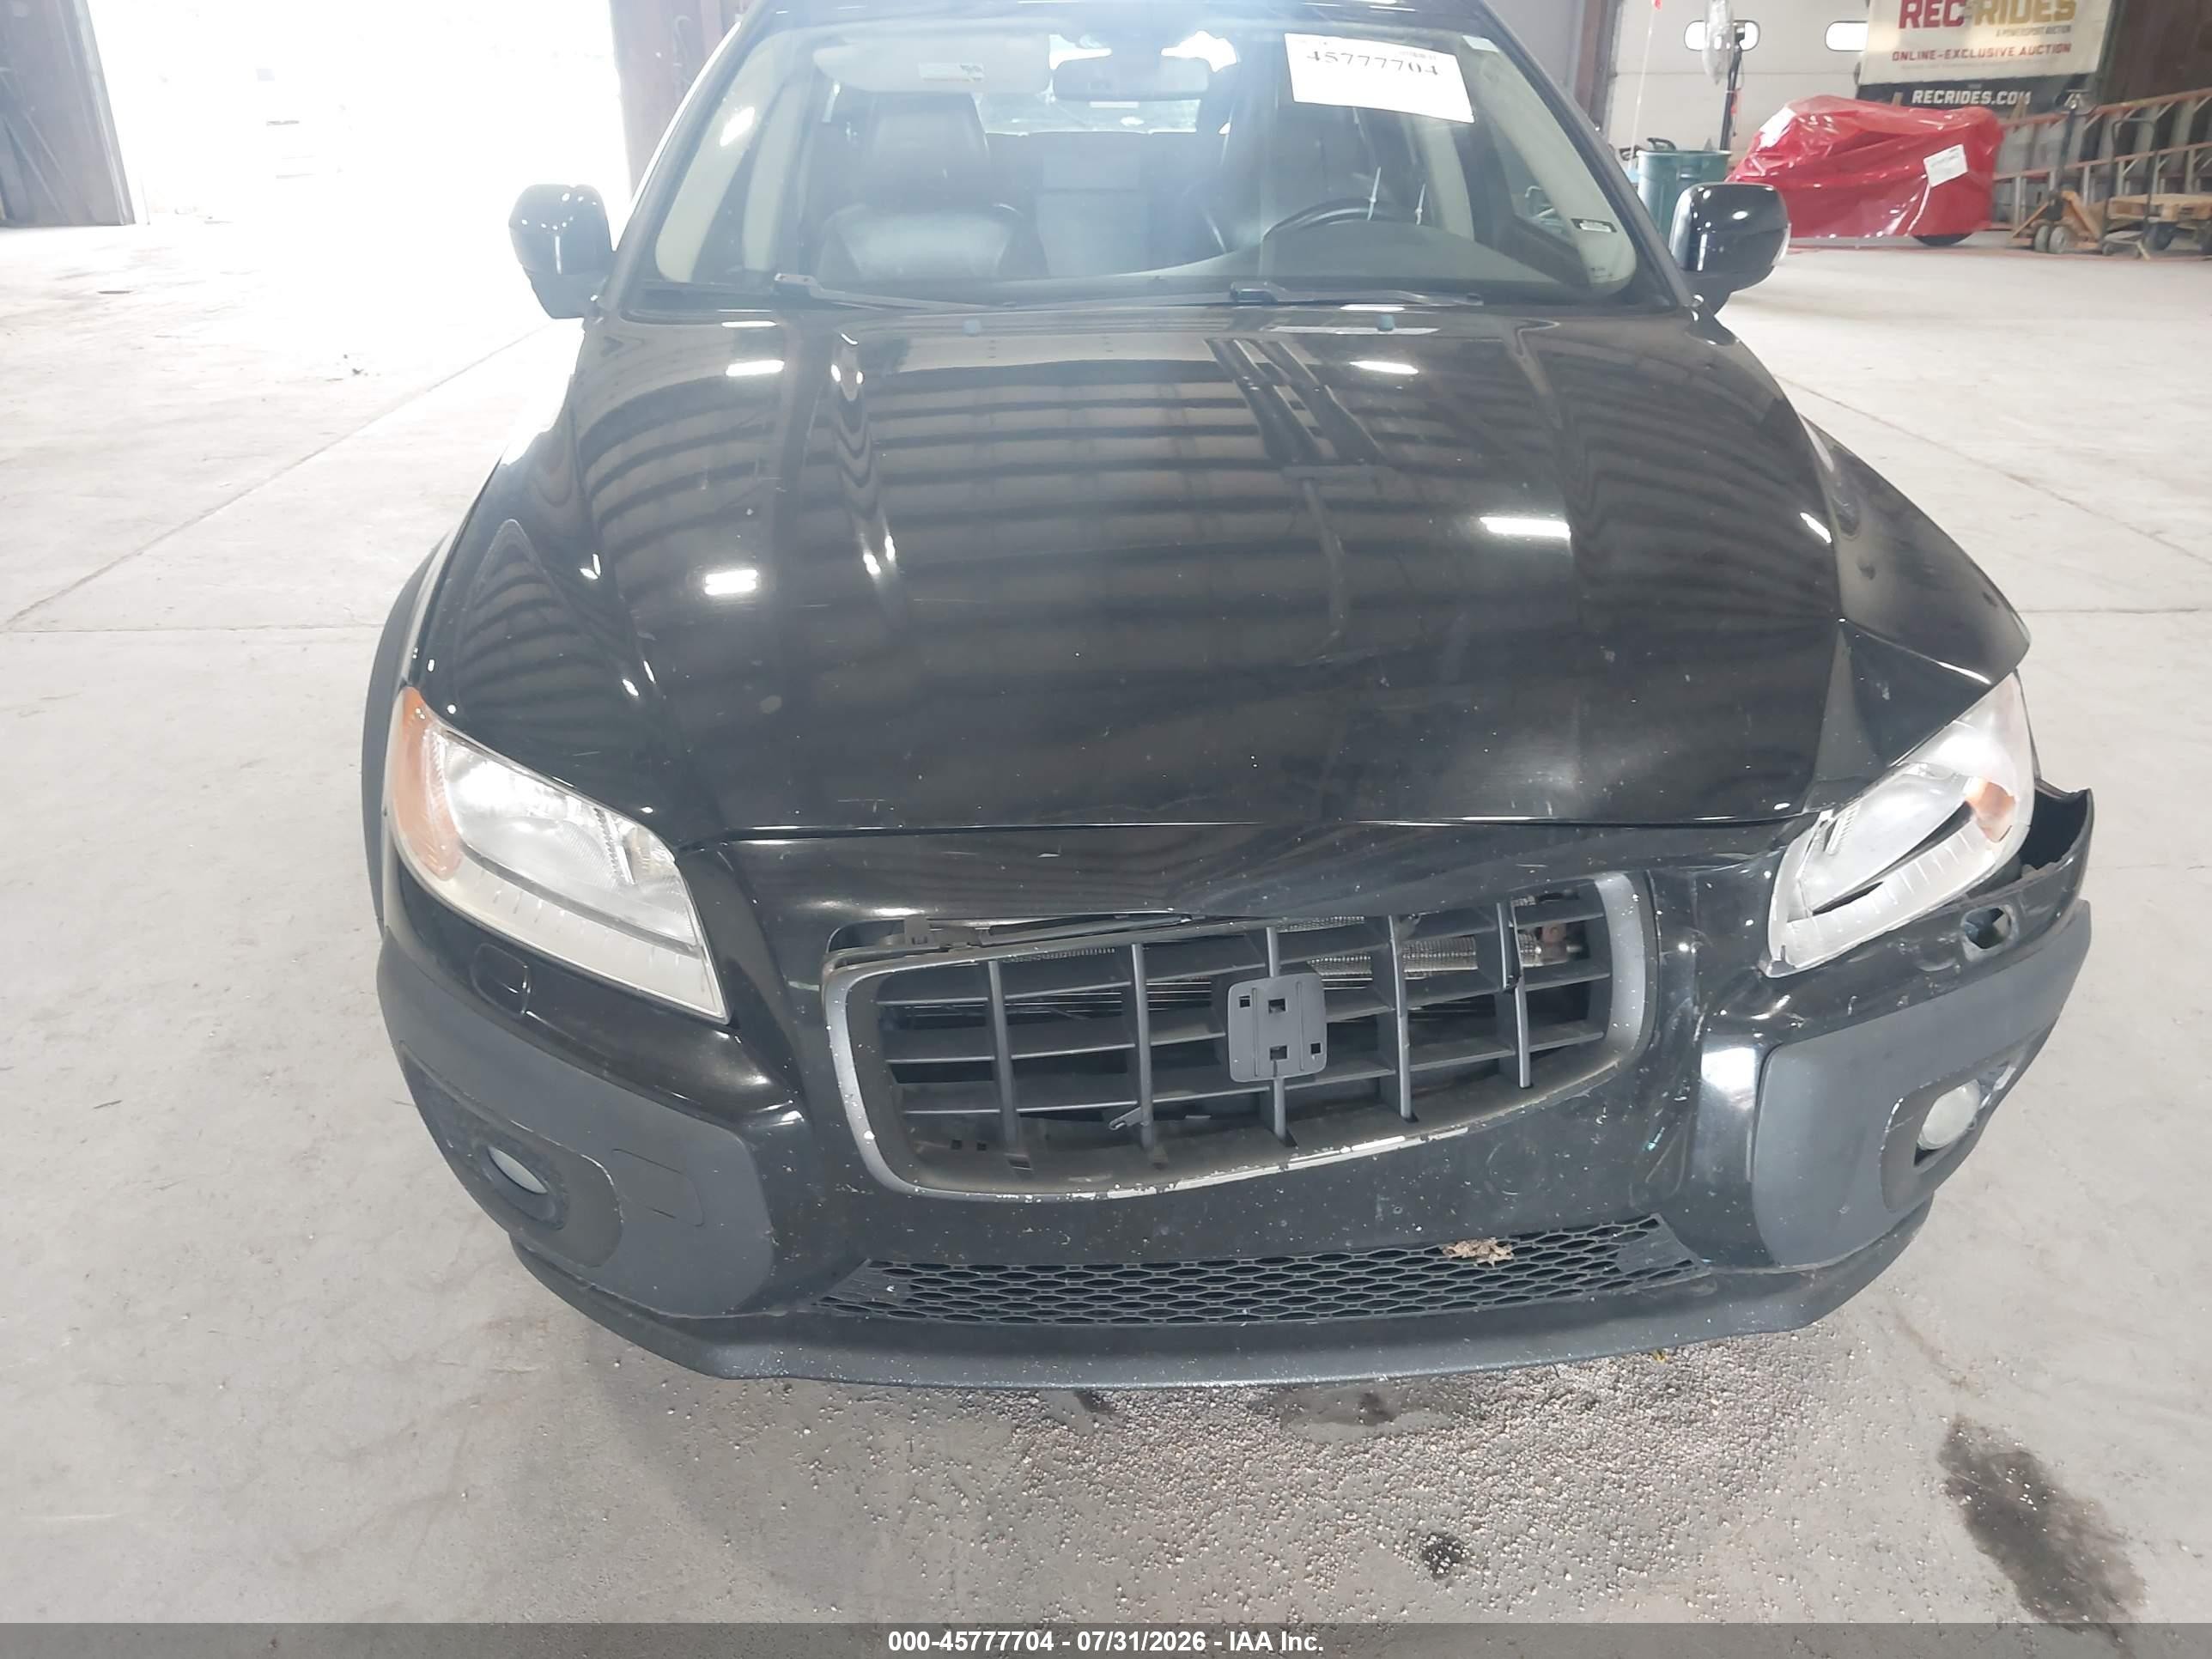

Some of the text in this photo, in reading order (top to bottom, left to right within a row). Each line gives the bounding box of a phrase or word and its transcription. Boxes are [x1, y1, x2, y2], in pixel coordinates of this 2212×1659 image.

[1899, 0, 2076, 29] REC RIDES
[1307, 50, 1439, 76] 45777704
[1892, 43, 2071, 62] ONLINE-EXCLUSIVE AUCTION
